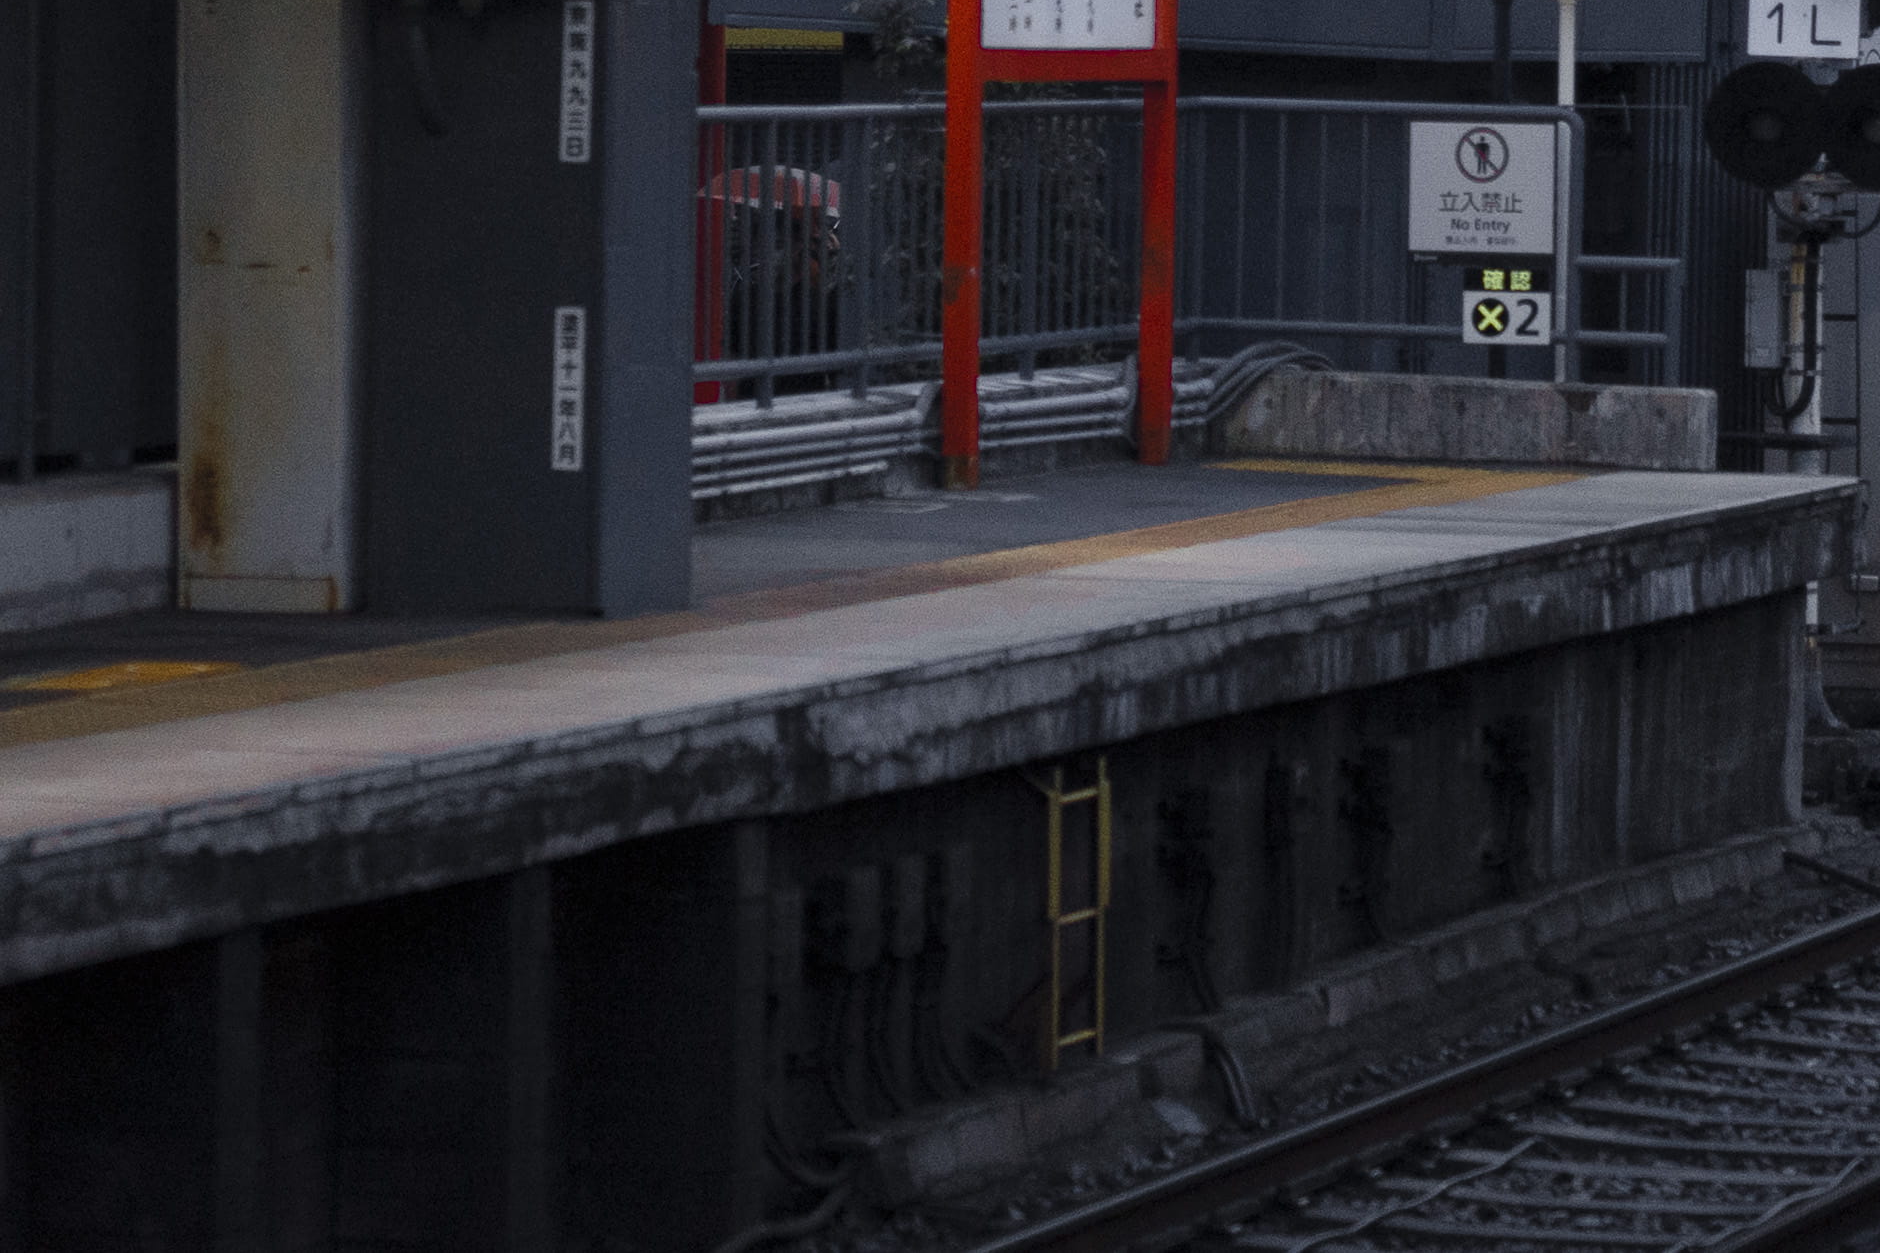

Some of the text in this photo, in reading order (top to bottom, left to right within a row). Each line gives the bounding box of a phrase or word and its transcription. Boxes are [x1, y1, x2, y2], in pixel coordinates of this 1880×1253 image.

[1439, 191, 1523, 214] 立入禁止
[1450, 218, 1511, 233] No Entry
[1481, 269, 1533, 291] 確認
[1514, 298, 1540, 337] 2
